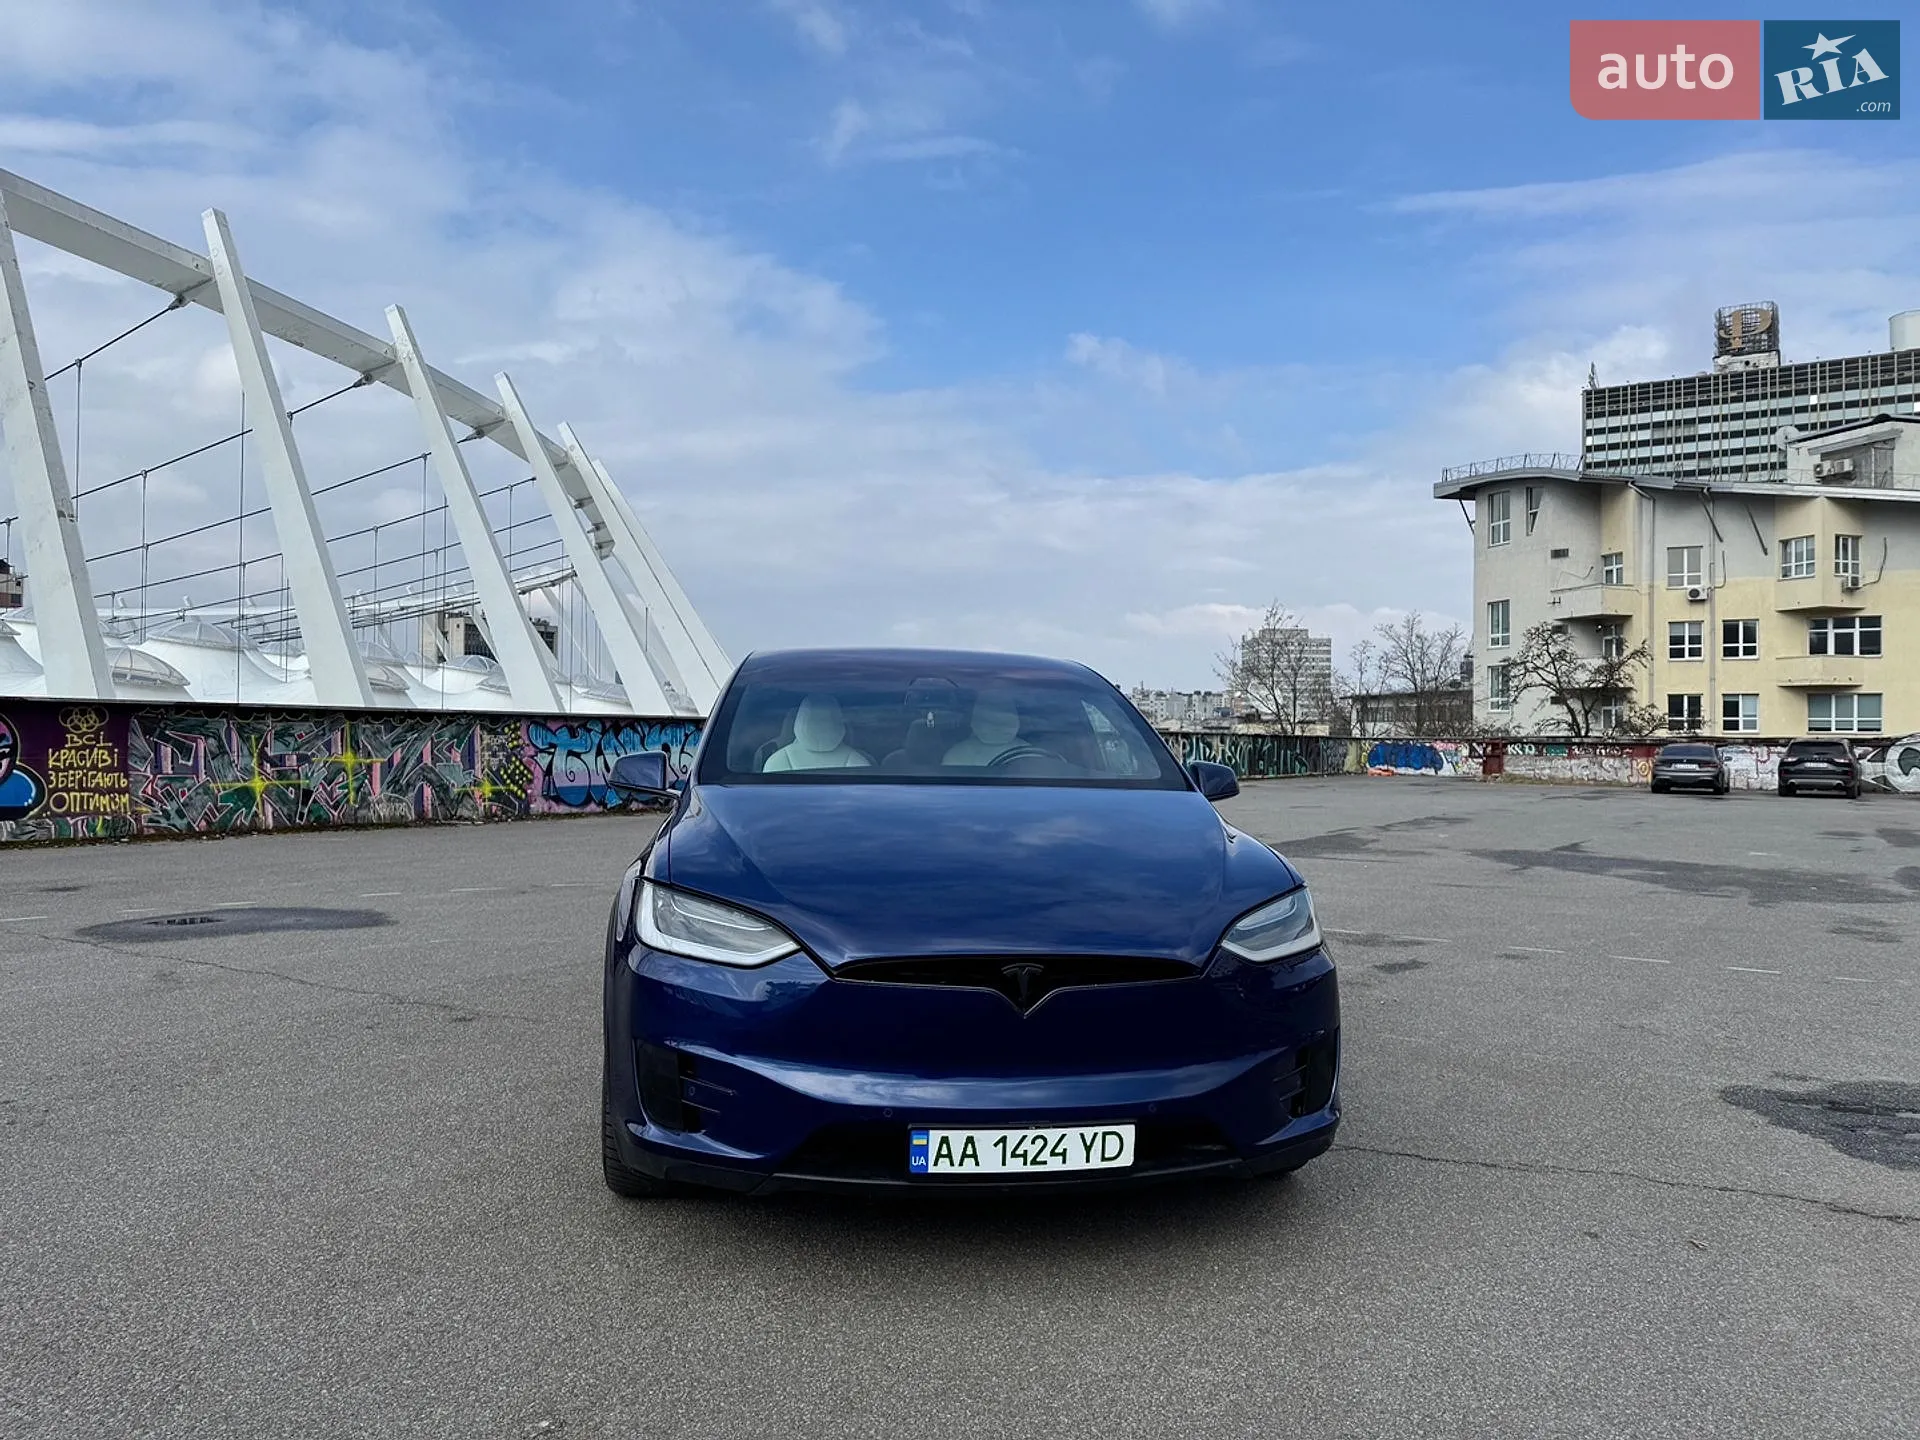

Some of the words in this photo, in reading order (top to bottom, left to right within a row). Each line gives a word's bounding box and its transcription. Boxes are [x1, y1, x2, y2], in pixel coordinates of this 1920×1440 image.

[911, 1155, 927, 1167] UA
[932, 1135, 980, 1168] AA
[992, 1133, 1068, 1167] 1424
[1079, 1130, 1125, 1165] YD
